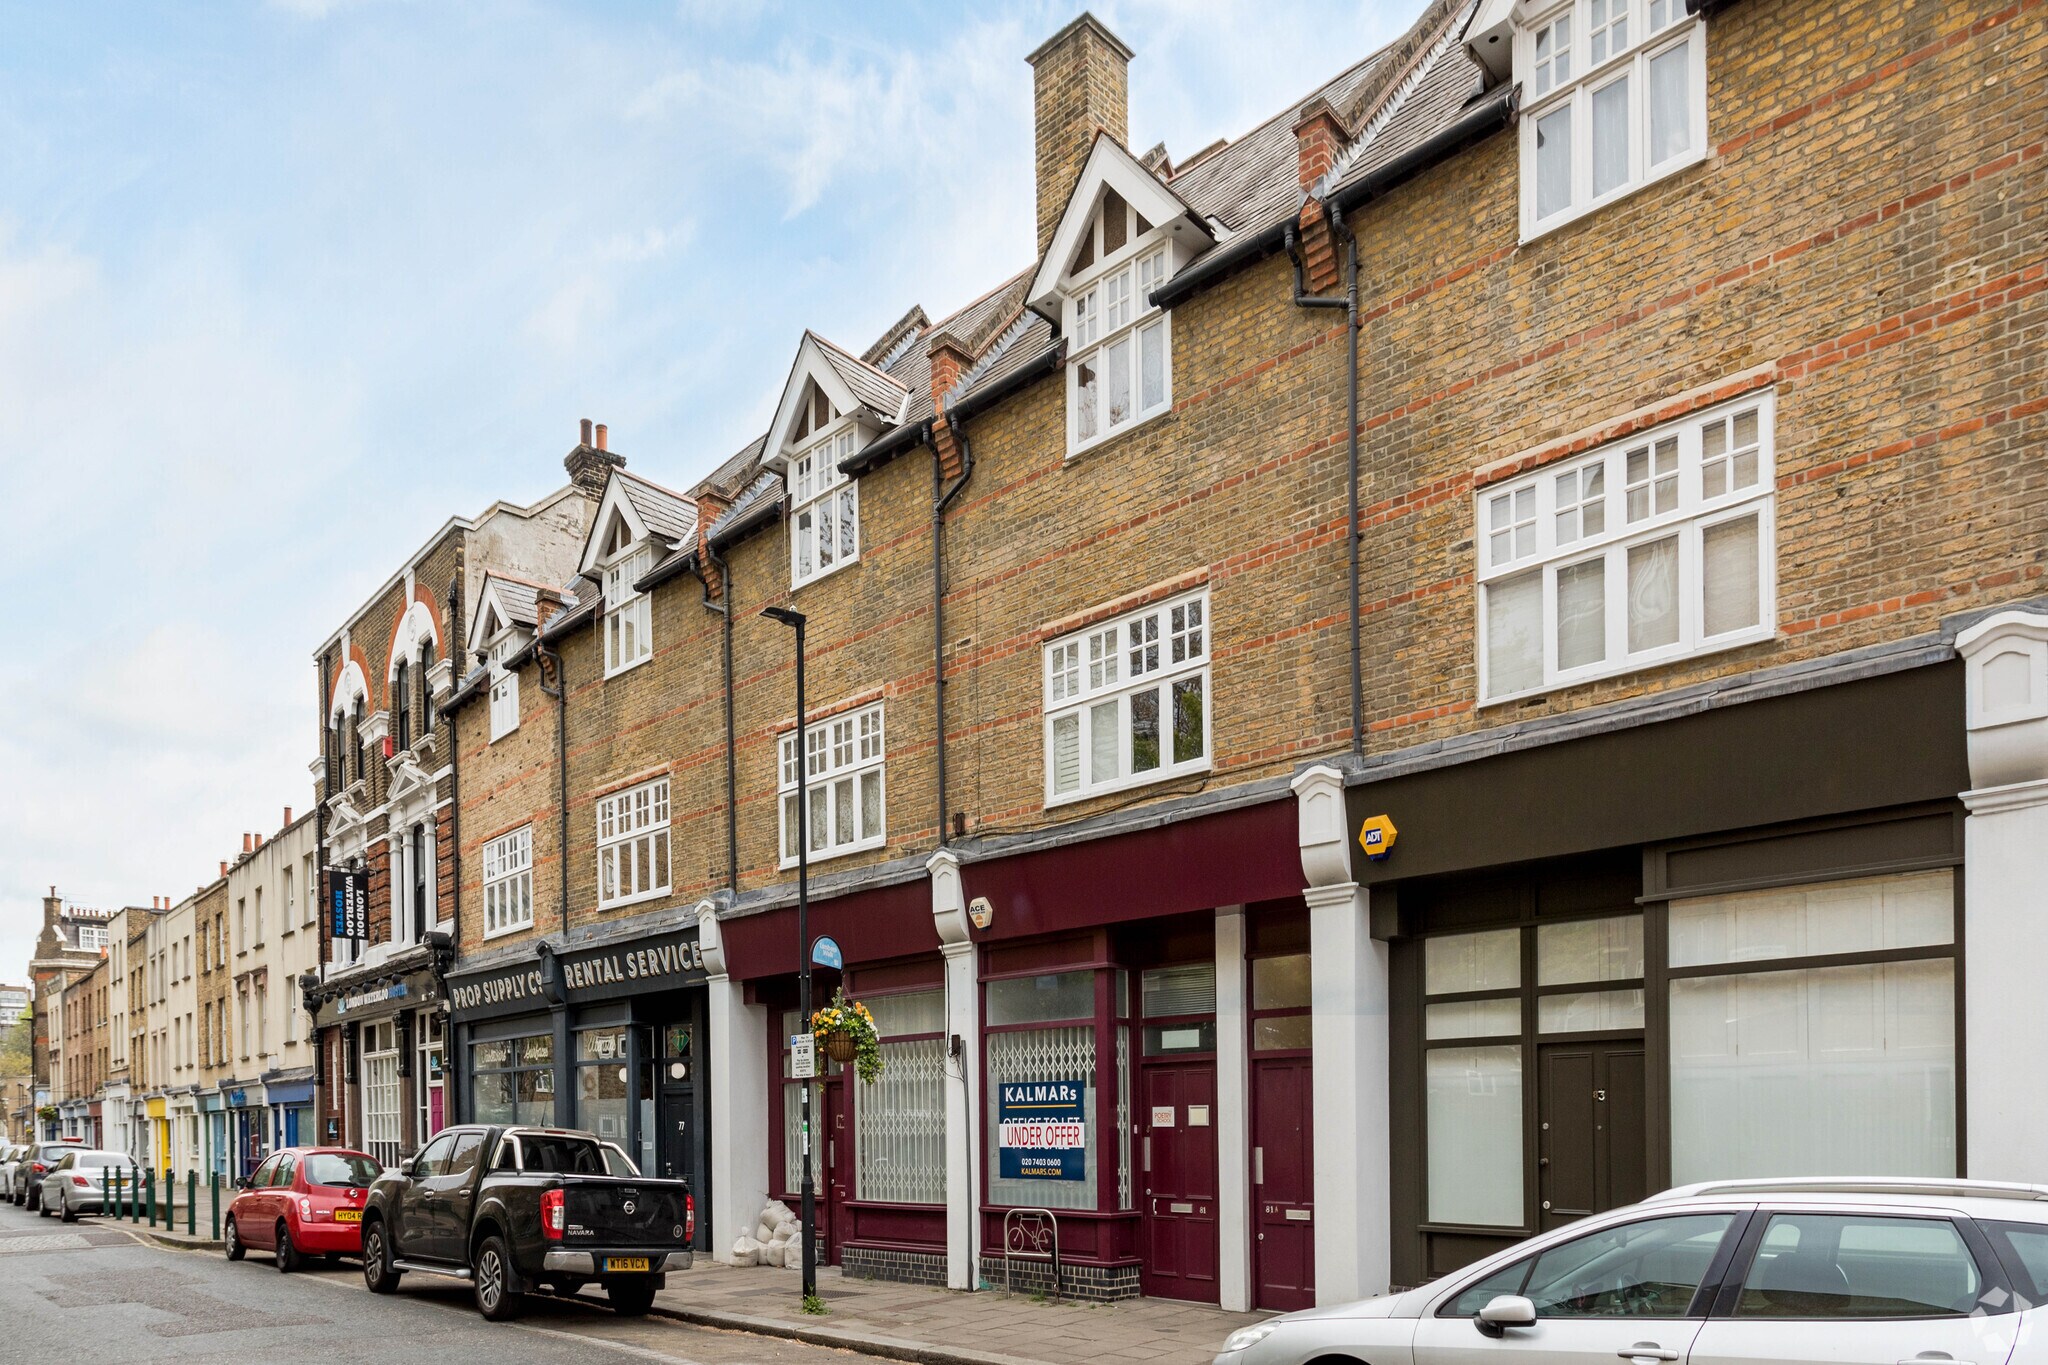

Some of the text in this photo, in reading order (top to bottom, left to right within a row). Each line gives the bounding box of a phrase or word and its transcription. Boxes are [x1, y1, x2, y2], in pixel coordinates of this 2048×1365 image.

[1366, 830, 1381, 844] ADT
[345, 875, 354, 937] WATERLOO
[970, 904, 985, 913] ACE
[335, 890, 344, 935] HOSTEL
[356, 889, 365, 937] LONDON
[563, 940, 705, 990] RENTAL SERVICE
[452, 984, 481, 1010] PROP
[482, 973, 526, 1005] SUPPLY
[1592, 1090, 1605, 1101] 83
[678, 1121, 685, 1131] 77
[1007, 1126, 1080, 1146] UNDER OFFER
[1021, 1158, 1061, 1166] 020 7403 0600
[1021, 1168, 1062, 1176] KALMARS.COM
[1199, 1206, 1206, 1214] 81
[338, 1212, 356, 1220] HY04
[610, 1259, 646, 1269] WT16 VCX
